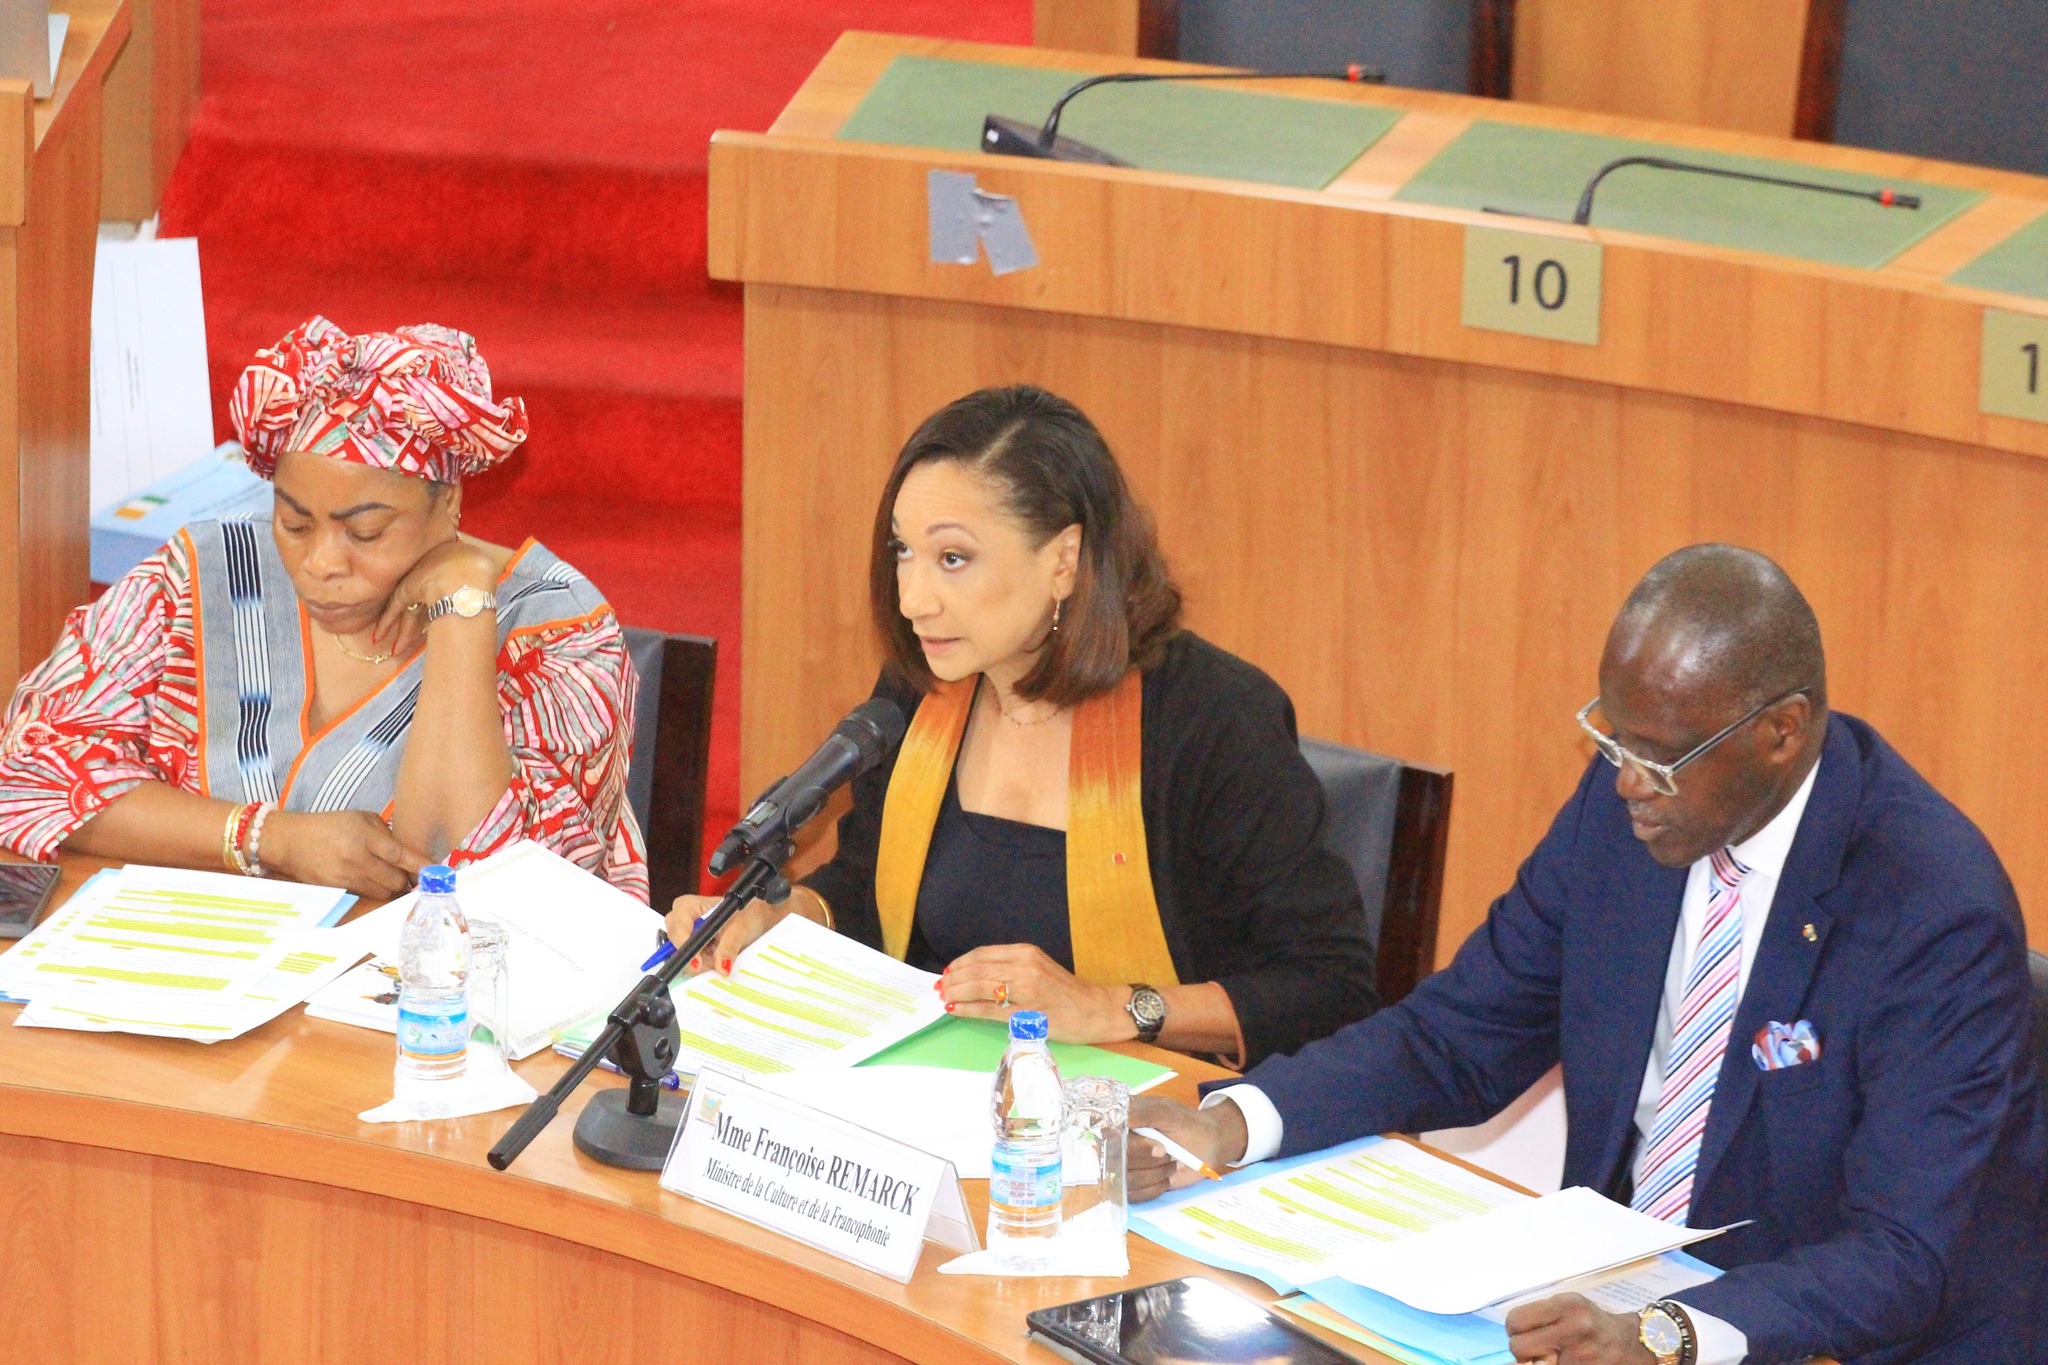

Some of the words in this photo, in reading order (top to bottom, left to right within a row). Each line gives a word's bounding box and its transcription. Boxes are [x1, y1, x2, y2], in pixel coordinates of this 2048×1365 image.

[1502, 253, 1569, 311] 10
[702, 1157, 743, 1190] Ministre
[740, 1172, 754, 1194] de
[752, 1176, 764, 1198] la
[763, 1180, 799, 1212] Culture
[797, 1197, 809, 1216] et
[807, 1197, 821, 1220] de
[818, 1201, 831, 1224] la
[829, 1205, 891, 1247] Francophonie
[710, 1111, 752, 1153] Mme
[752, 1127, 825, 1181] Françoise
[826, 1154, 921, 1217] REMARCK
